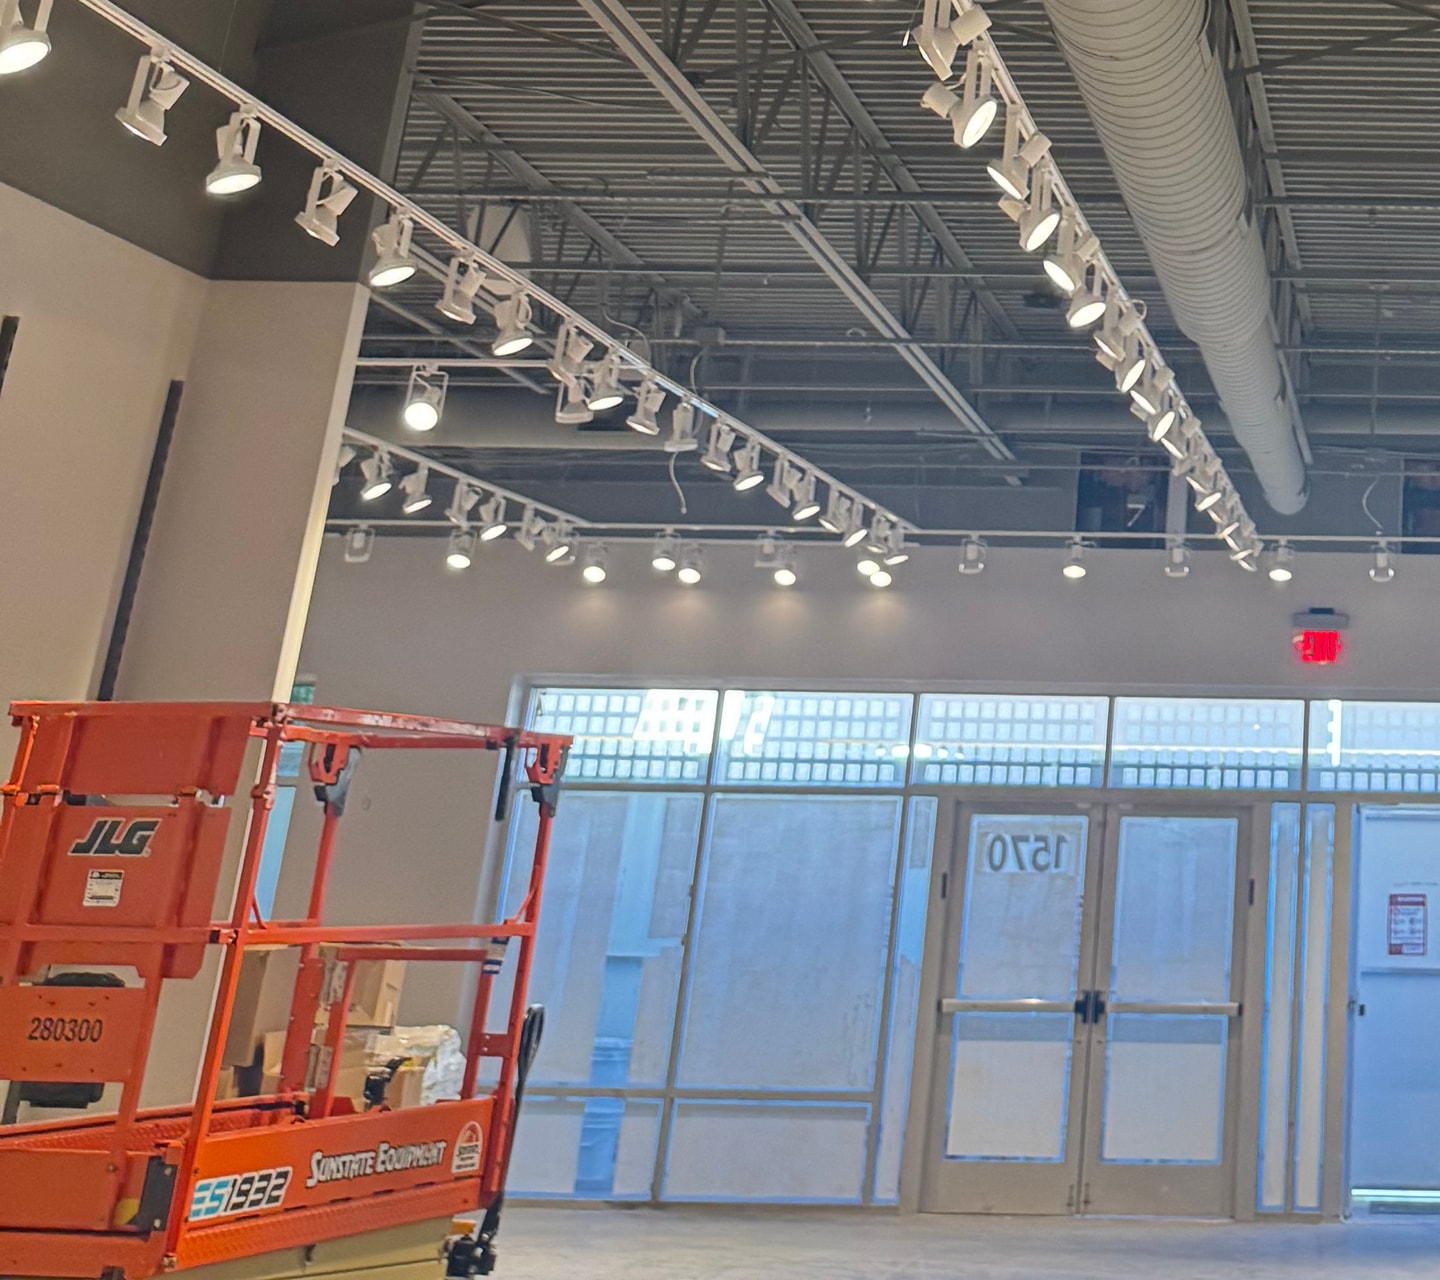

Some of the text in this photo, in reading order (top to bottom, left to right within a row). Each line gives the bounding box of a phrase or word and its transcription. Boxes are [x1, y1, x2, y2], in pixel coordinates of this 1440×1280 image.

[69, 818, 161, 856] JLG
[27, 1017, 103, 1043] 280300
[189, 1169, 291, 1219] ES1932
